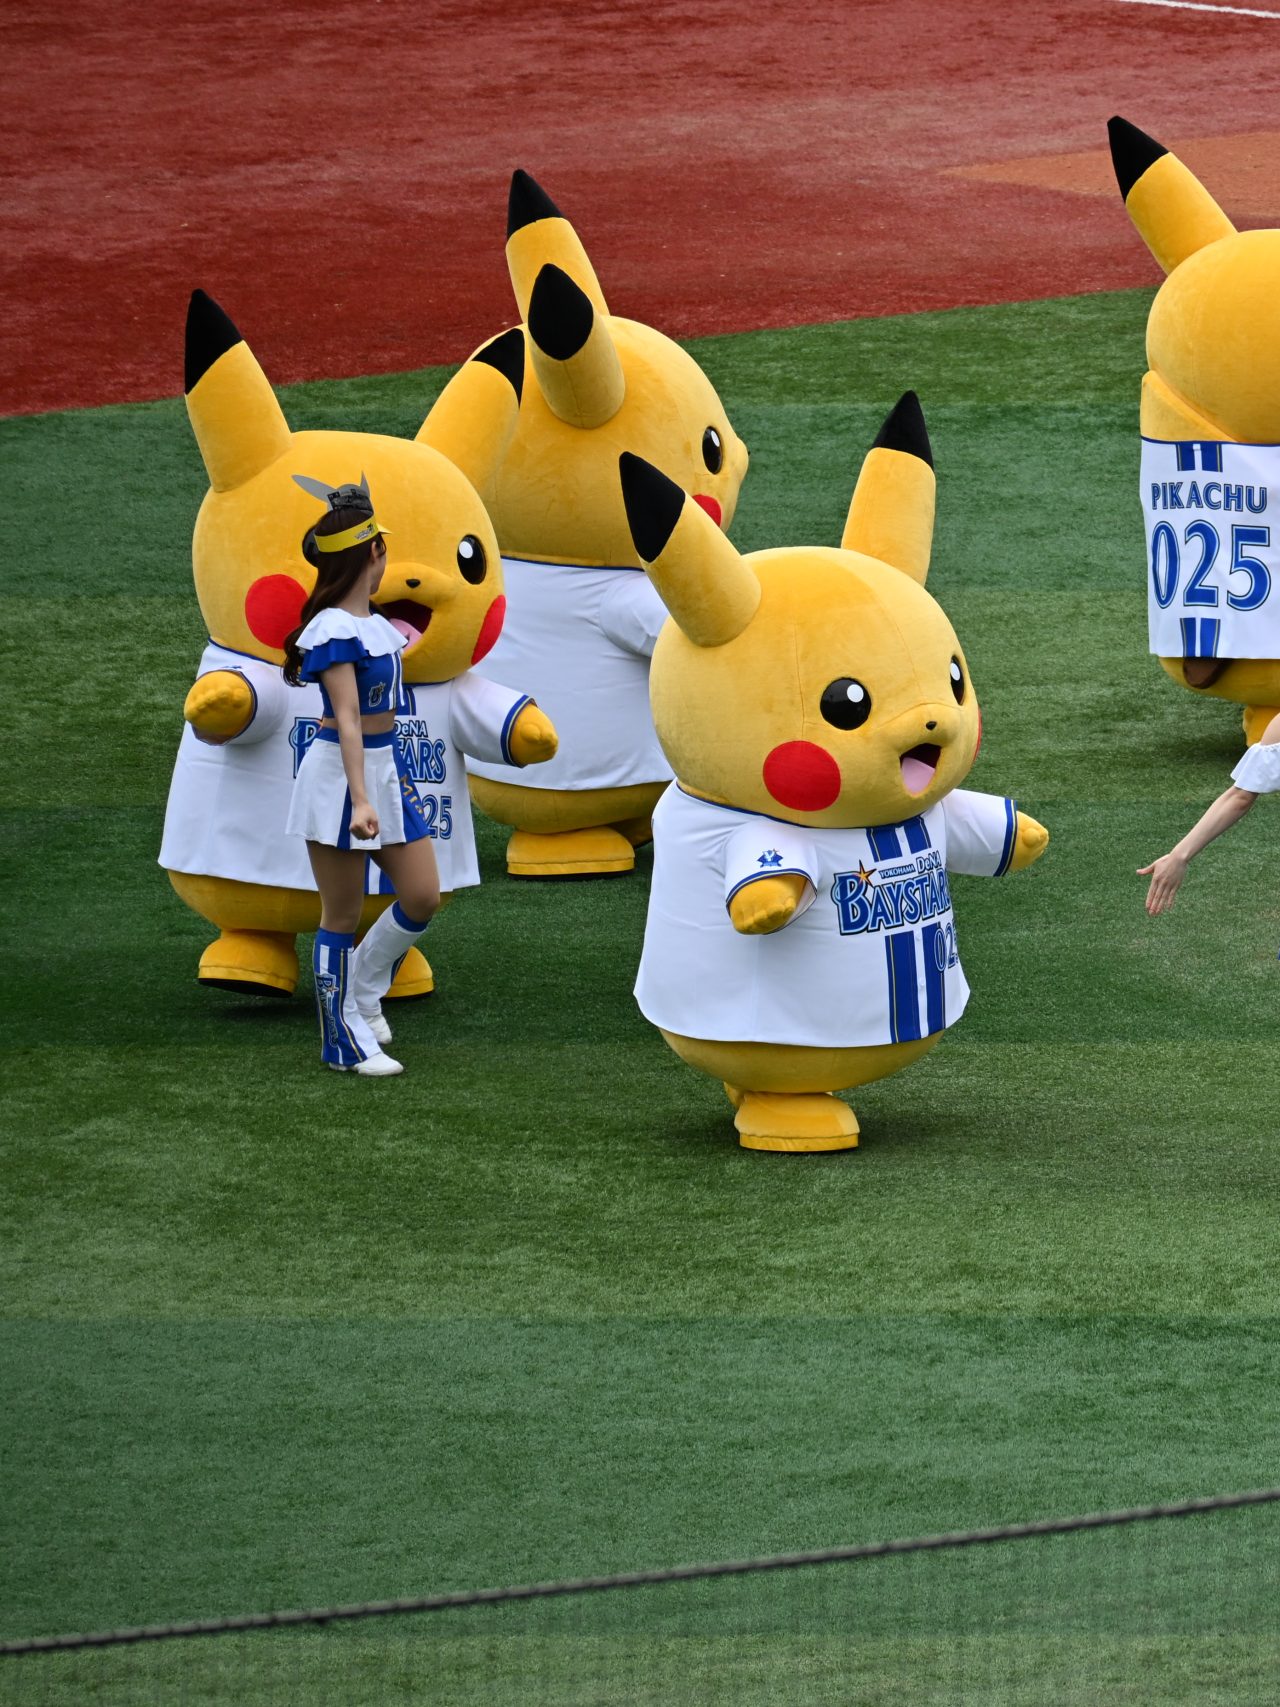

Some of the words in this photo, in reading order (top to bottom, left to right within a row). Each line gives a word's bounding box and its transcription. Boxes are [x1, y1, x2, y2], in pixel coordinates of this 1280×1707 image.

[1151, 481, 1267, 514] PIKACHU
[1152, 519, 1271, 611] 025
[421, 794, 452, 839] 25
[879, 864, 915, 879] YOKOHAMA
[916, 850, 942, 874] DeNA
[831, 867, 951, 936] BAYSTAR
[934, 922, 957, 972] 02
